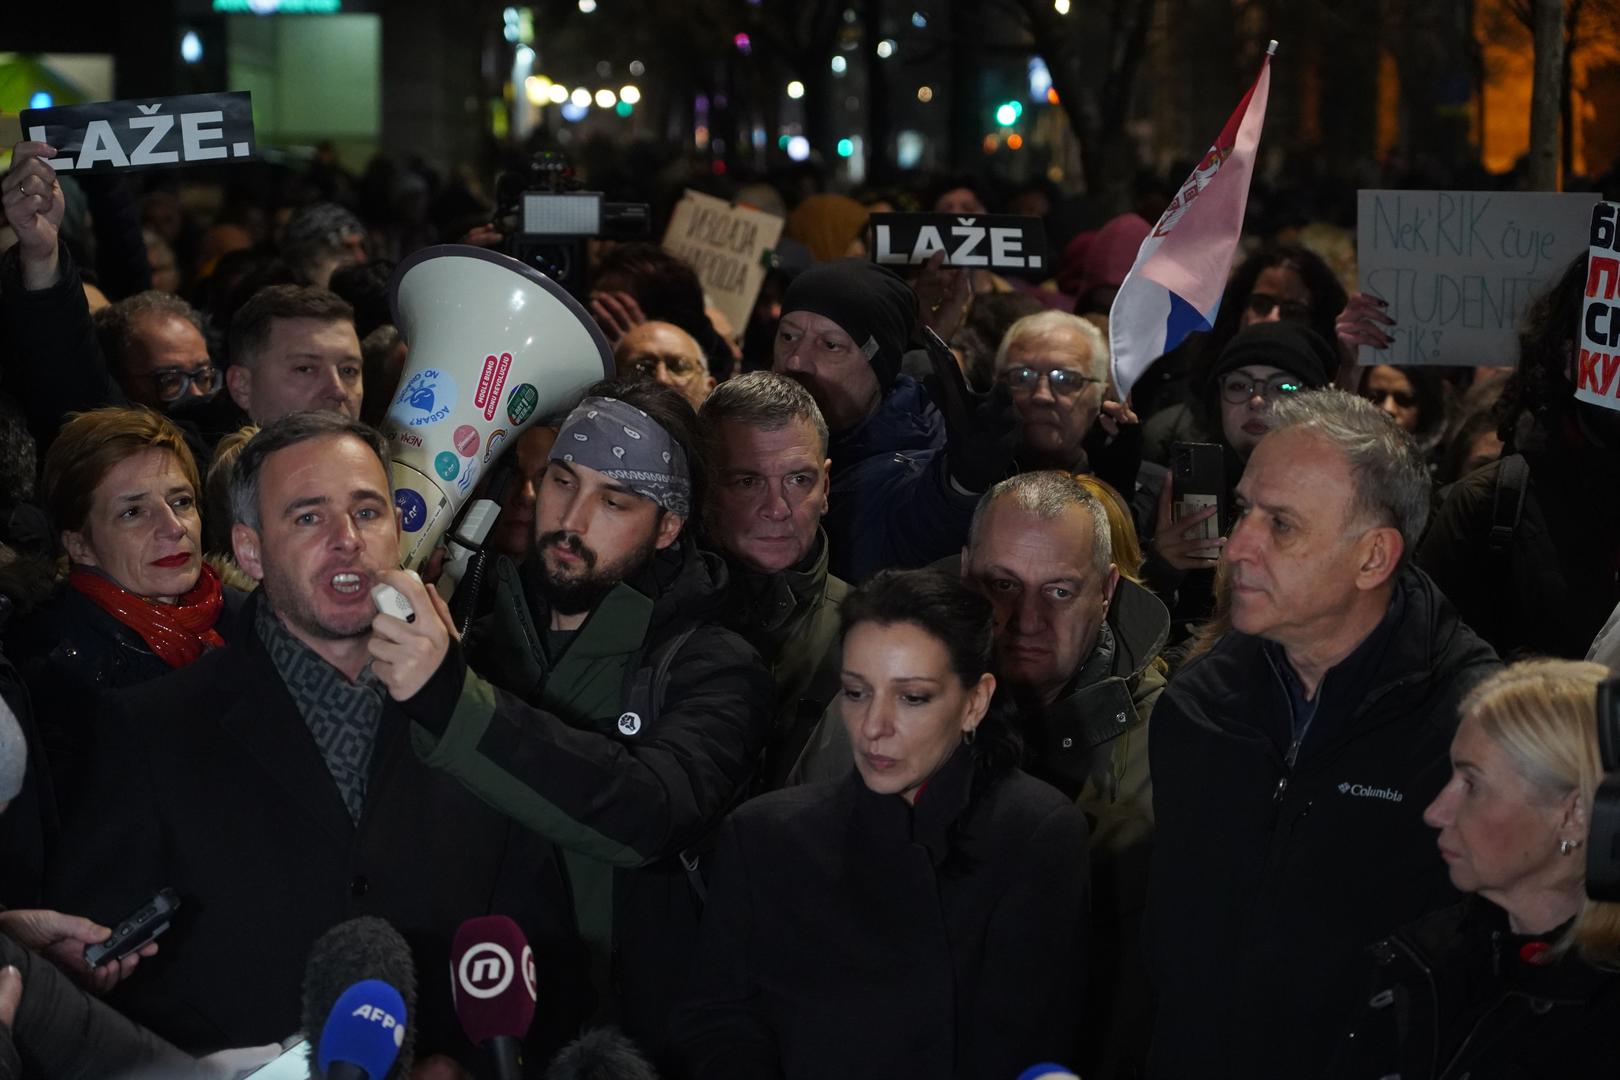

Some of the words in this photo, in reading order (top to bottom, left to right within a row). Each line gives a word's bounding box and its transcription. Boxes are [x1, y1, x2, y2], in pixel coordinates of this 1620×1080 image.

[28, 103, 250, 170] LAŽE.
[876, 217, 1042, 268] LAŽE.
[1436, 193, 1496, 260] RIK
[1501, 220, 1556, 274] čuje
[409, 405, 451, 426] AGBAR?
[1350, 783, 1404, 802] Columbia
[351, 1003, 397, 1029] AFP
